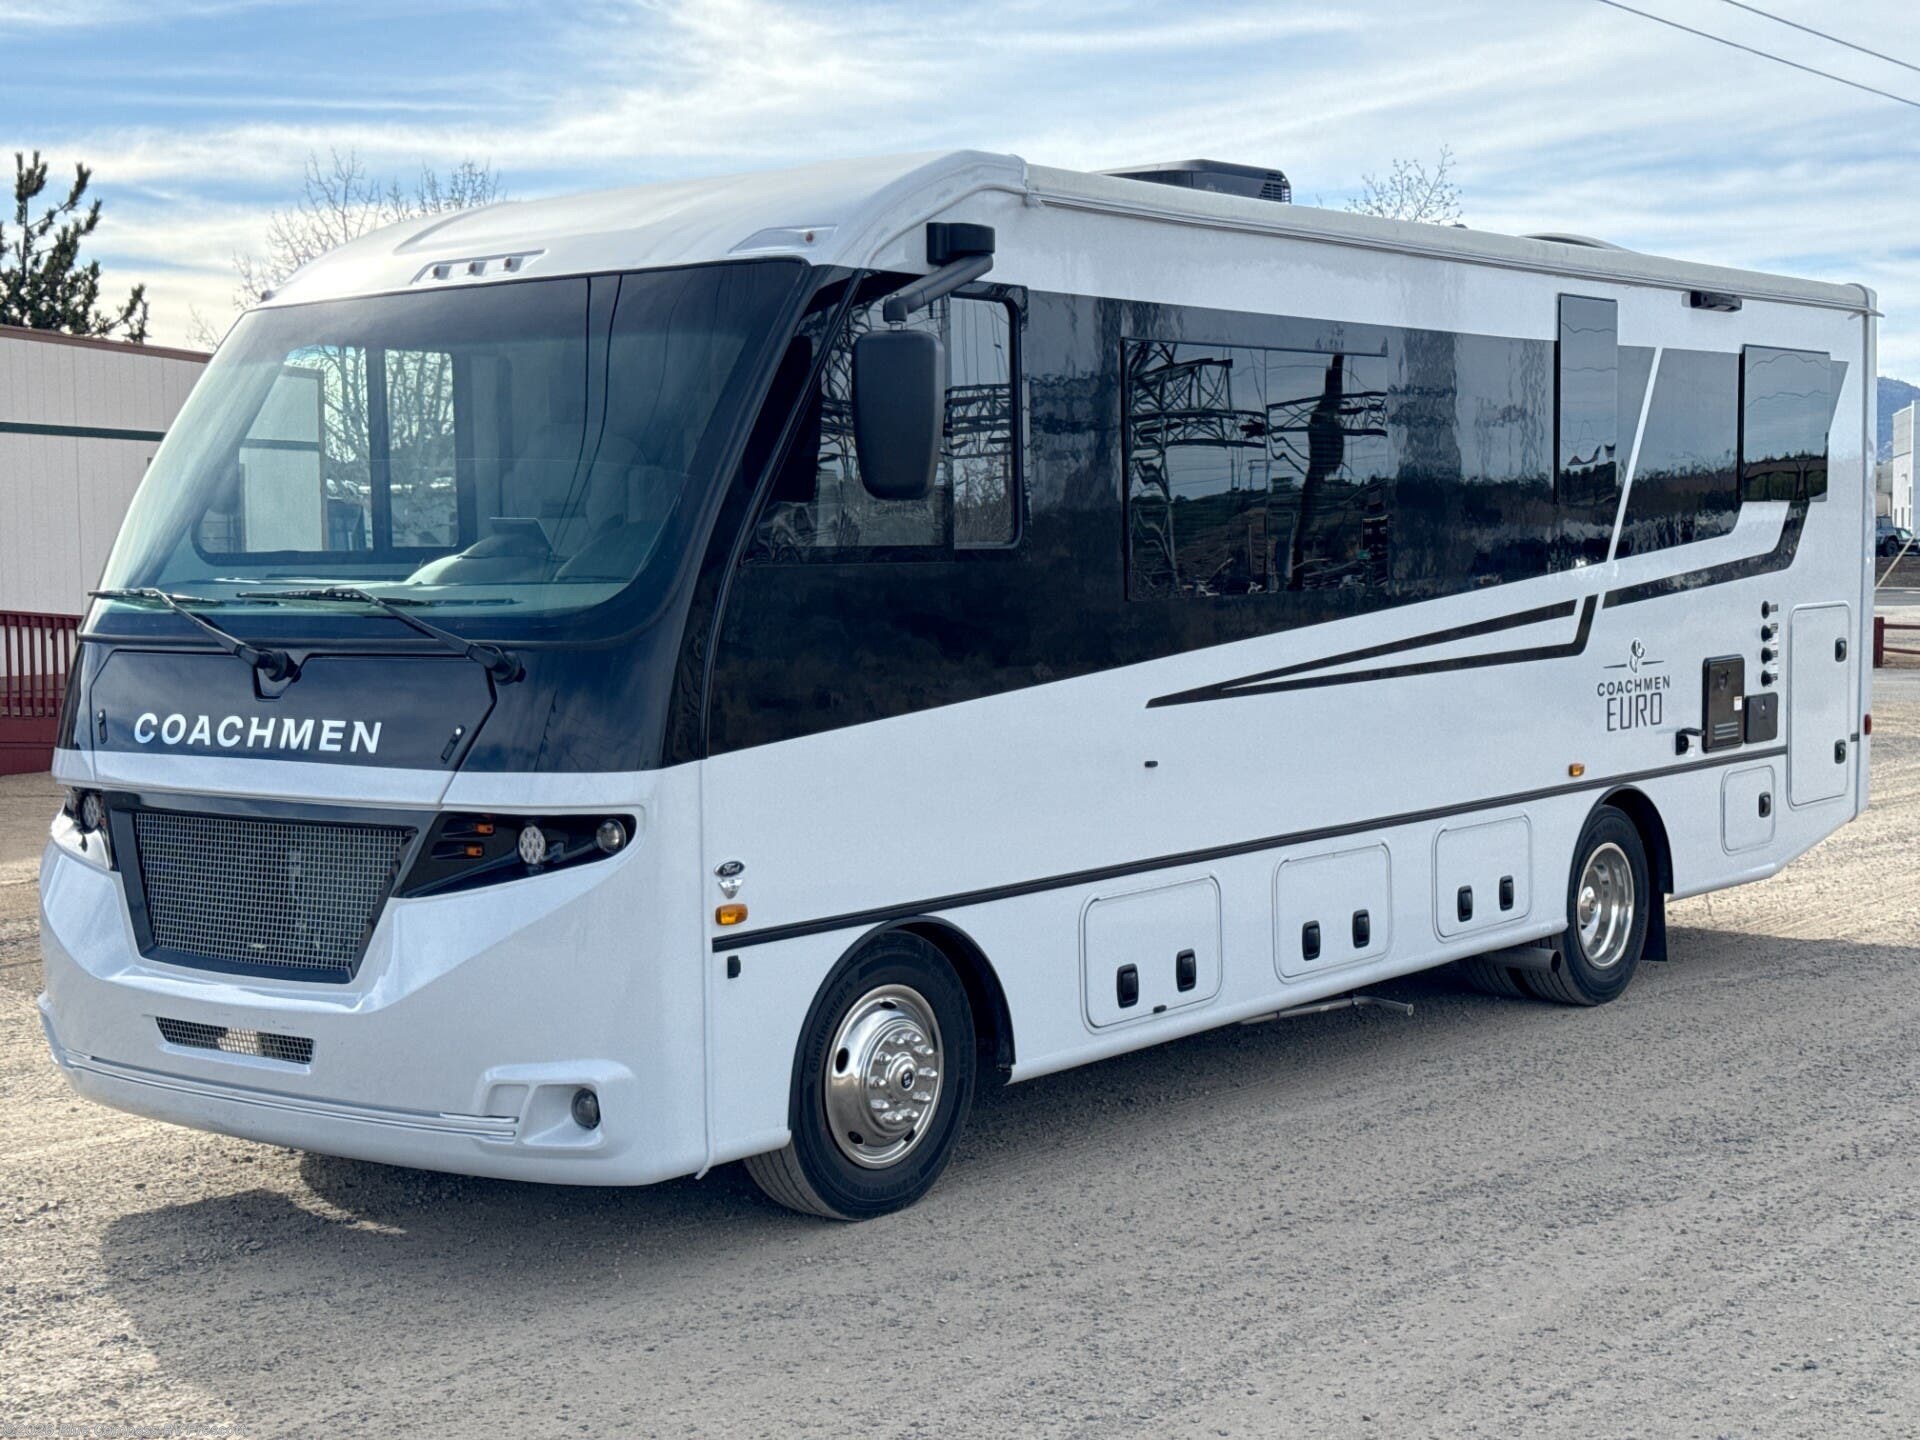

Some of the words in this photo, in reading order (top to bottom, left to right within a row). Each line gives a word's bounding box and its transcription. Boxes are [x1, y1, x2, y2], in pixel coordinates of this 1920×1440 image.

[1597, 675, 1671, 697] COACHMEN
[1607, 692, 1663, 732] EURO
[133, 712, 383, 754] COACHMEN
